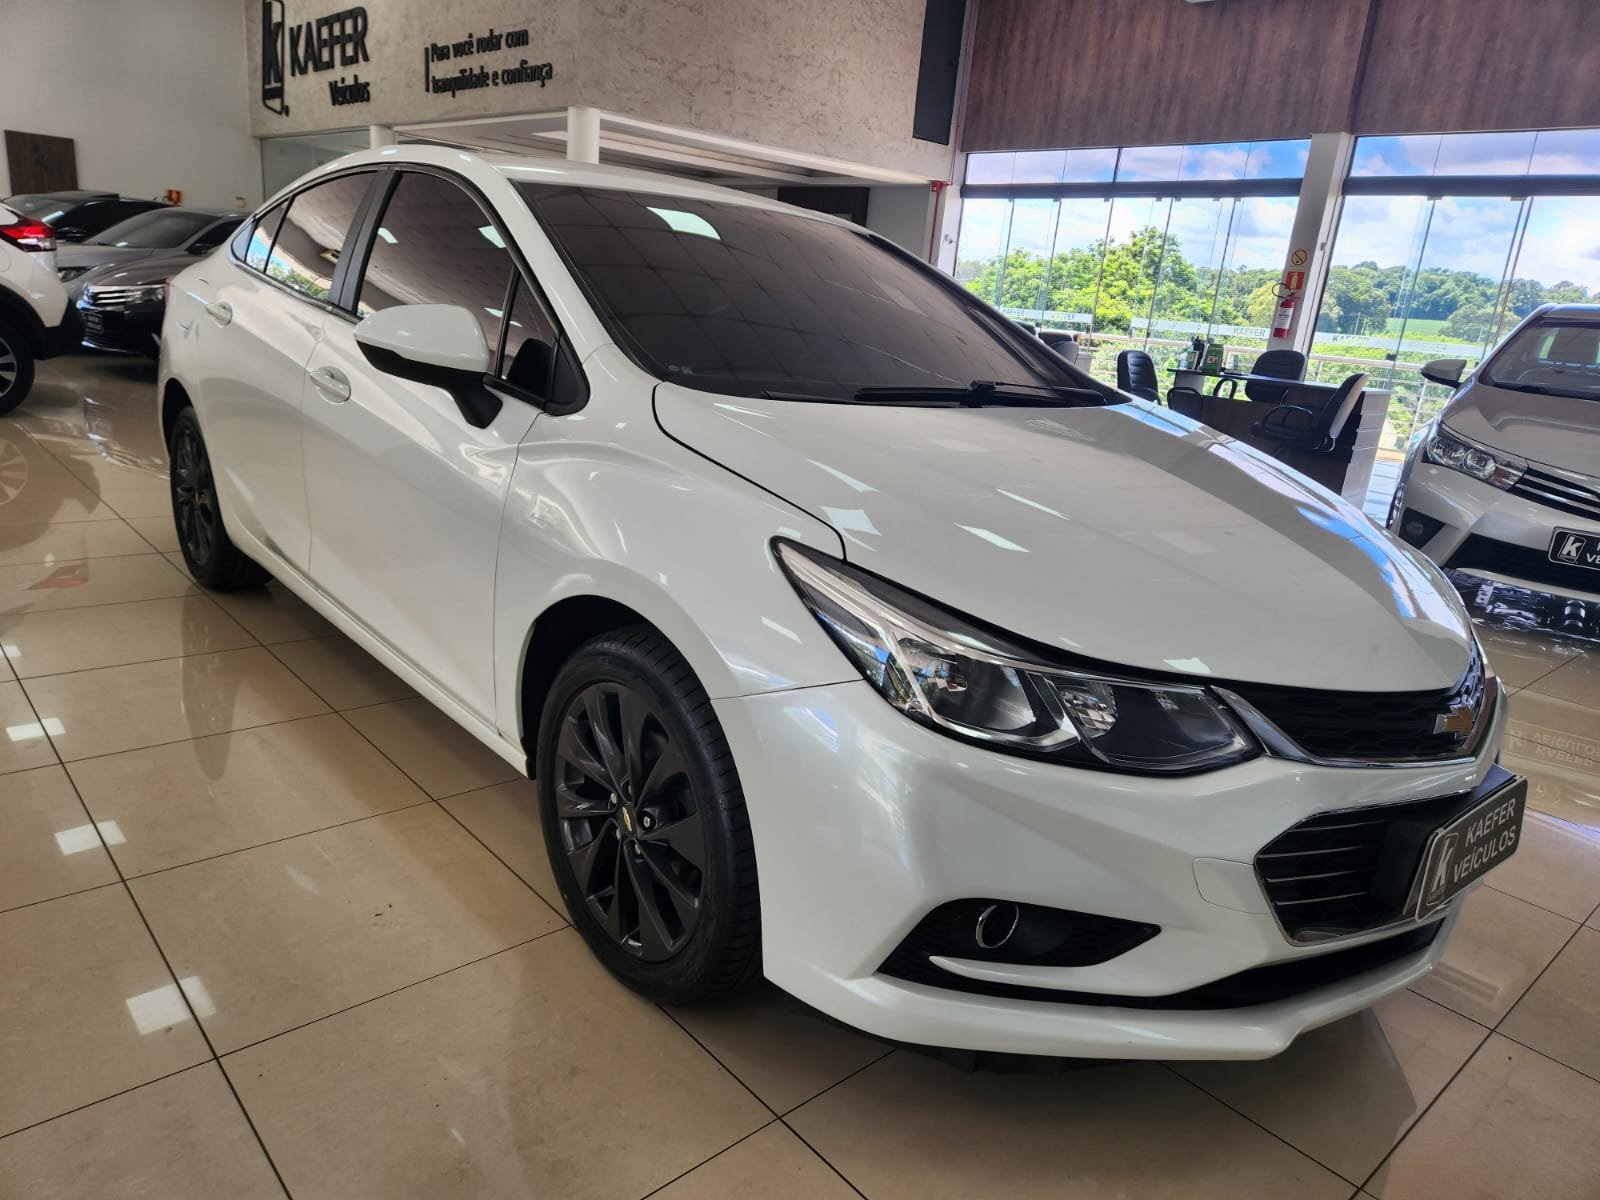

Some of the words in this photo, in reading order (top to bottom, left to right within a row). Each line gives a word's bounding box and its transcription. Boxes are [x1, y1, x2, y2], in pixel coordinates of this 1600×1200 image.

[289, 6, 370, 77] KAEFER
[430, 43, 451, 63] Para
[451, 32, 474, 58] você
[476, 28, 503, 54] rodar
[505, 29, 529, 49] com
[328, 74, 371, 106] Veículos
[492, 70, 499, 86] e
[501, 59, 553, 88] confiança
[1233, 327, 1266, 337] KAEFER
[1464, 797, 1517, 848] KAEFER
[1453, 825, 1517, 884] VEÍCULOS
